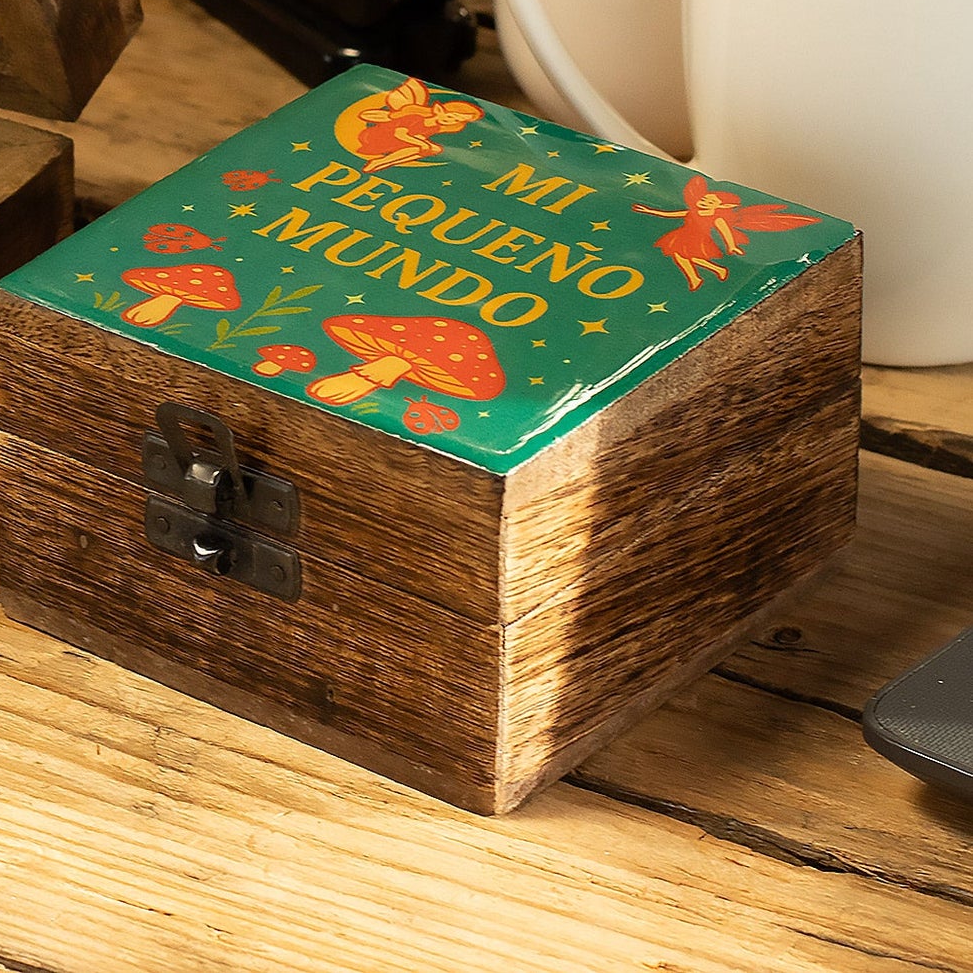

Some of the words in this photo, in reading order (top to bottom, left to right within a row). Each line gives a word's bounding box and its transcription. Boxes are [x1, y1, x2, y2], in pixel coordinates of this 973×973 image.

[290, 161, 645, 300] PEQUEÑO
[481, 162, 598, 215] MI
[251, 206, 548, 327] MUNDO
